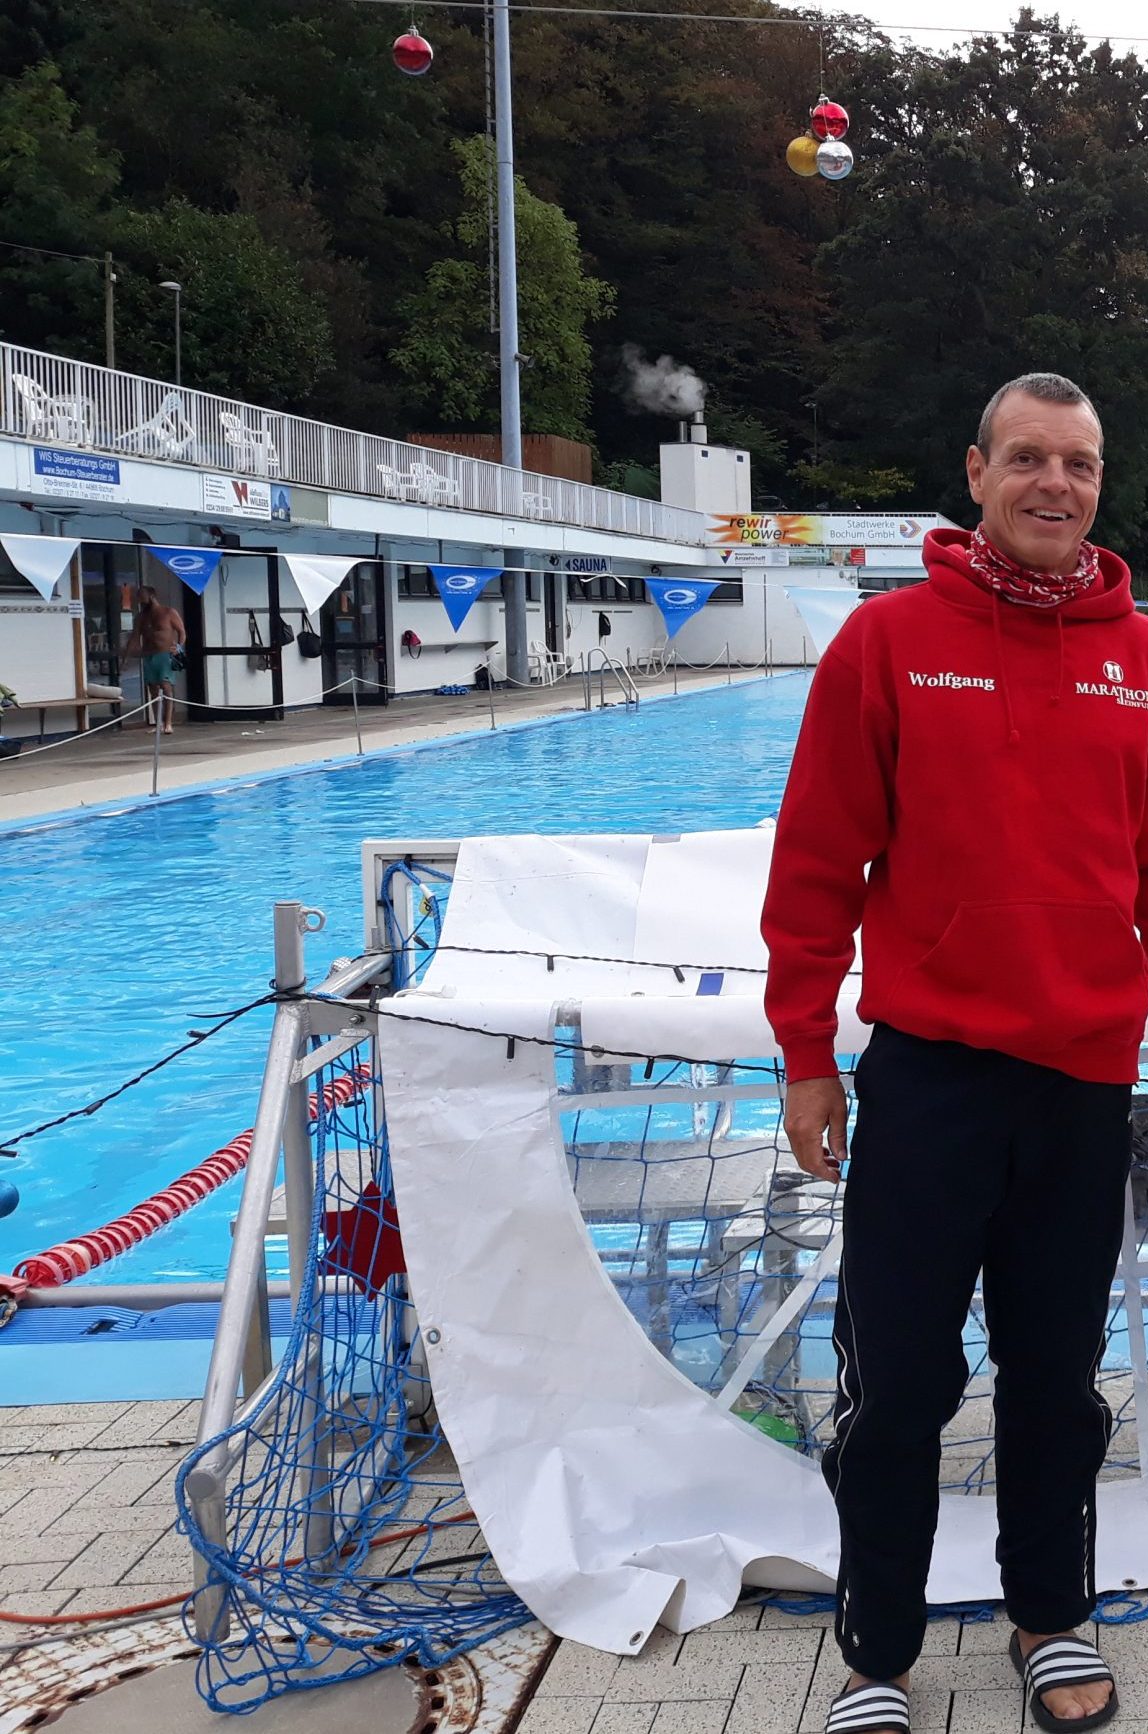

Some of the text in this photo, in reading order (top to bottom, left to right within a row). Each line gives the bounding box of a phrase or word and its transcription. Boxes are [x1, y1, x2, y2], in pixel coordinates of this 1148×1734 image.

[38, 451, 52, 462] WIS
[98, 460, 116, 471] GmbH
[729, 515, 772, 529] rewir
[847, 519, 895, 529] Stadtwerke
[740, 527, 790, 542] power
[830, 529, 895, 539] Bochum GmbH
[572, 558, 607, 572] SAUNA
[908, 671, 995, 691] Wolfgang
